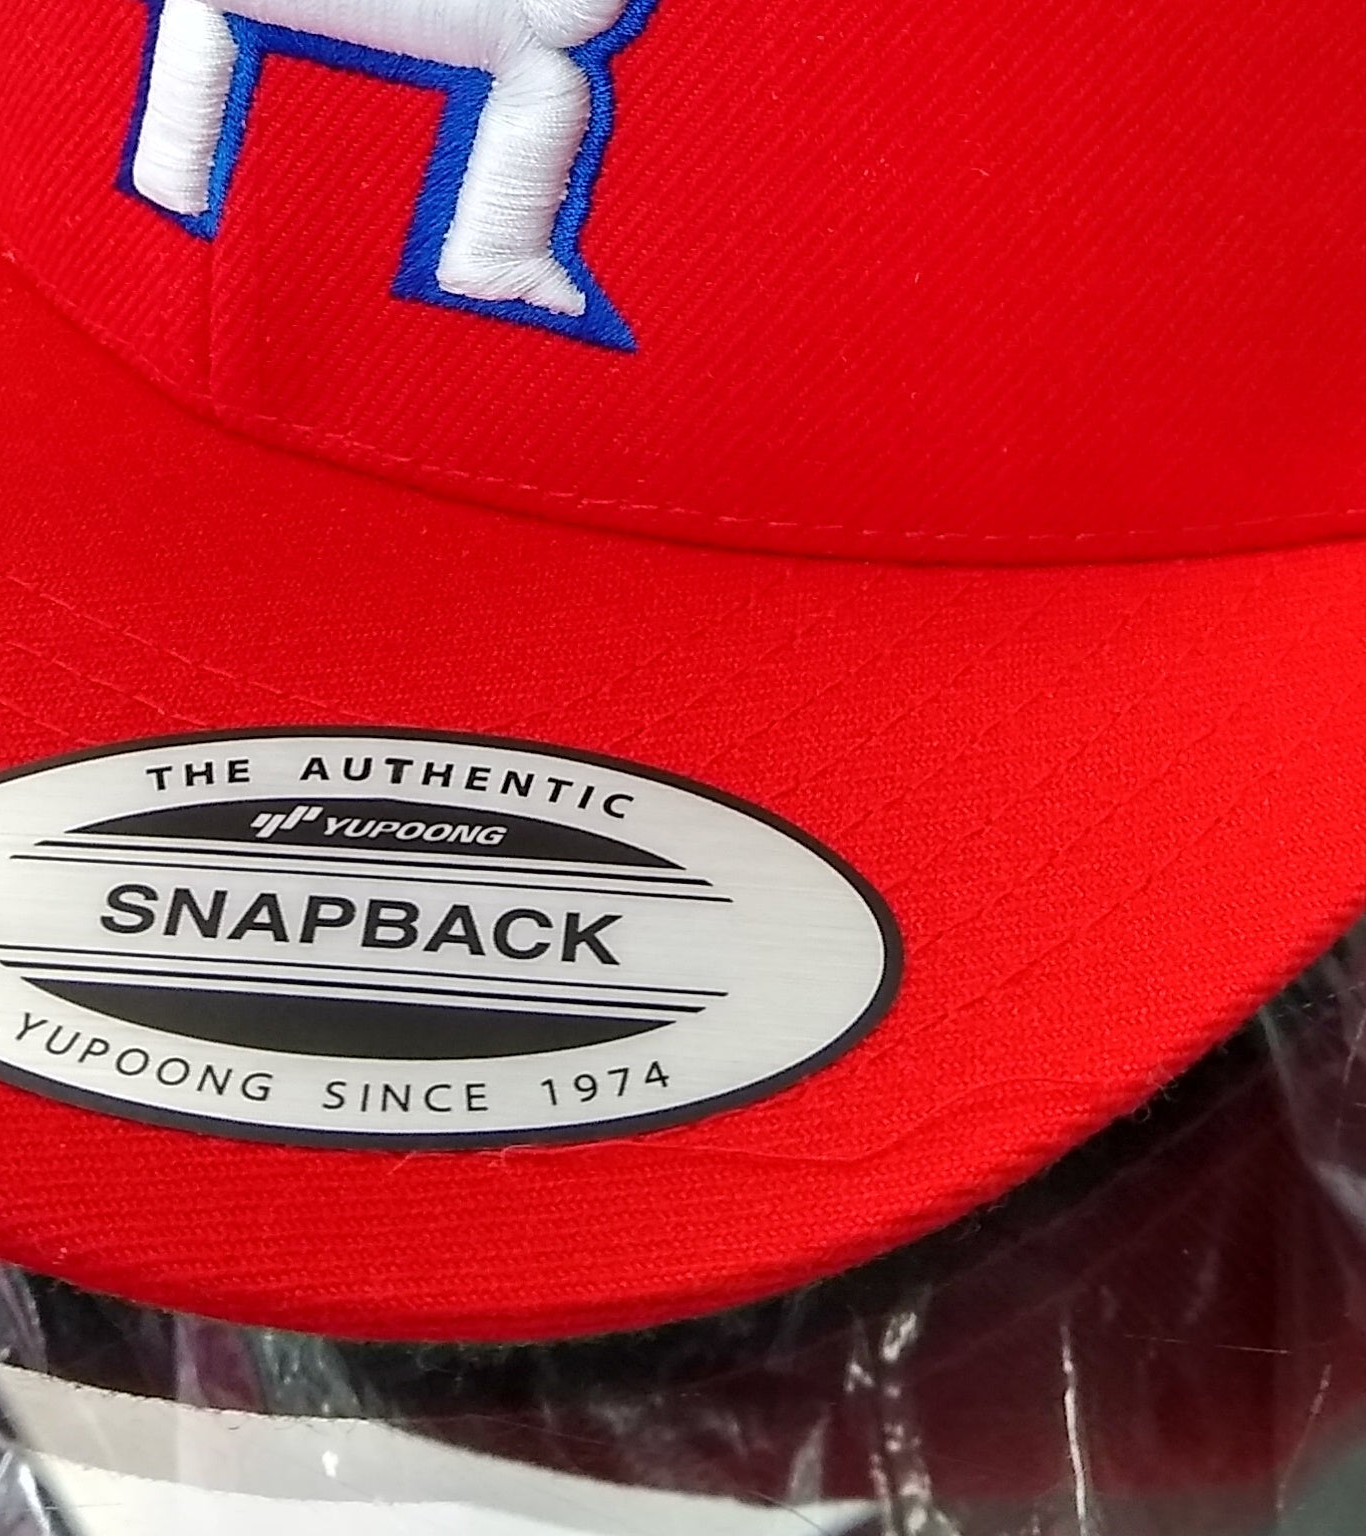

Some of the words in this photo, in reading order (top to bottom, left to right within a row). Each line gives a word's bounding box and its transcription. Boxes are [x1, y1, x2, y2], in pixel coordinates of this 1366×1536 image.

[146, 758, 251, 791] THE
[299, 756, 635, 819] AUTHENTIC
[322, 815, 508, 846] YUPOONG
[99, 883, 624, 966] SNAPBACK
[14, 1011, 274, 1102] YUPOONG
[321, 1080, 489, 1113] SINCE
[540, 1060, 670, 1107] 1974
